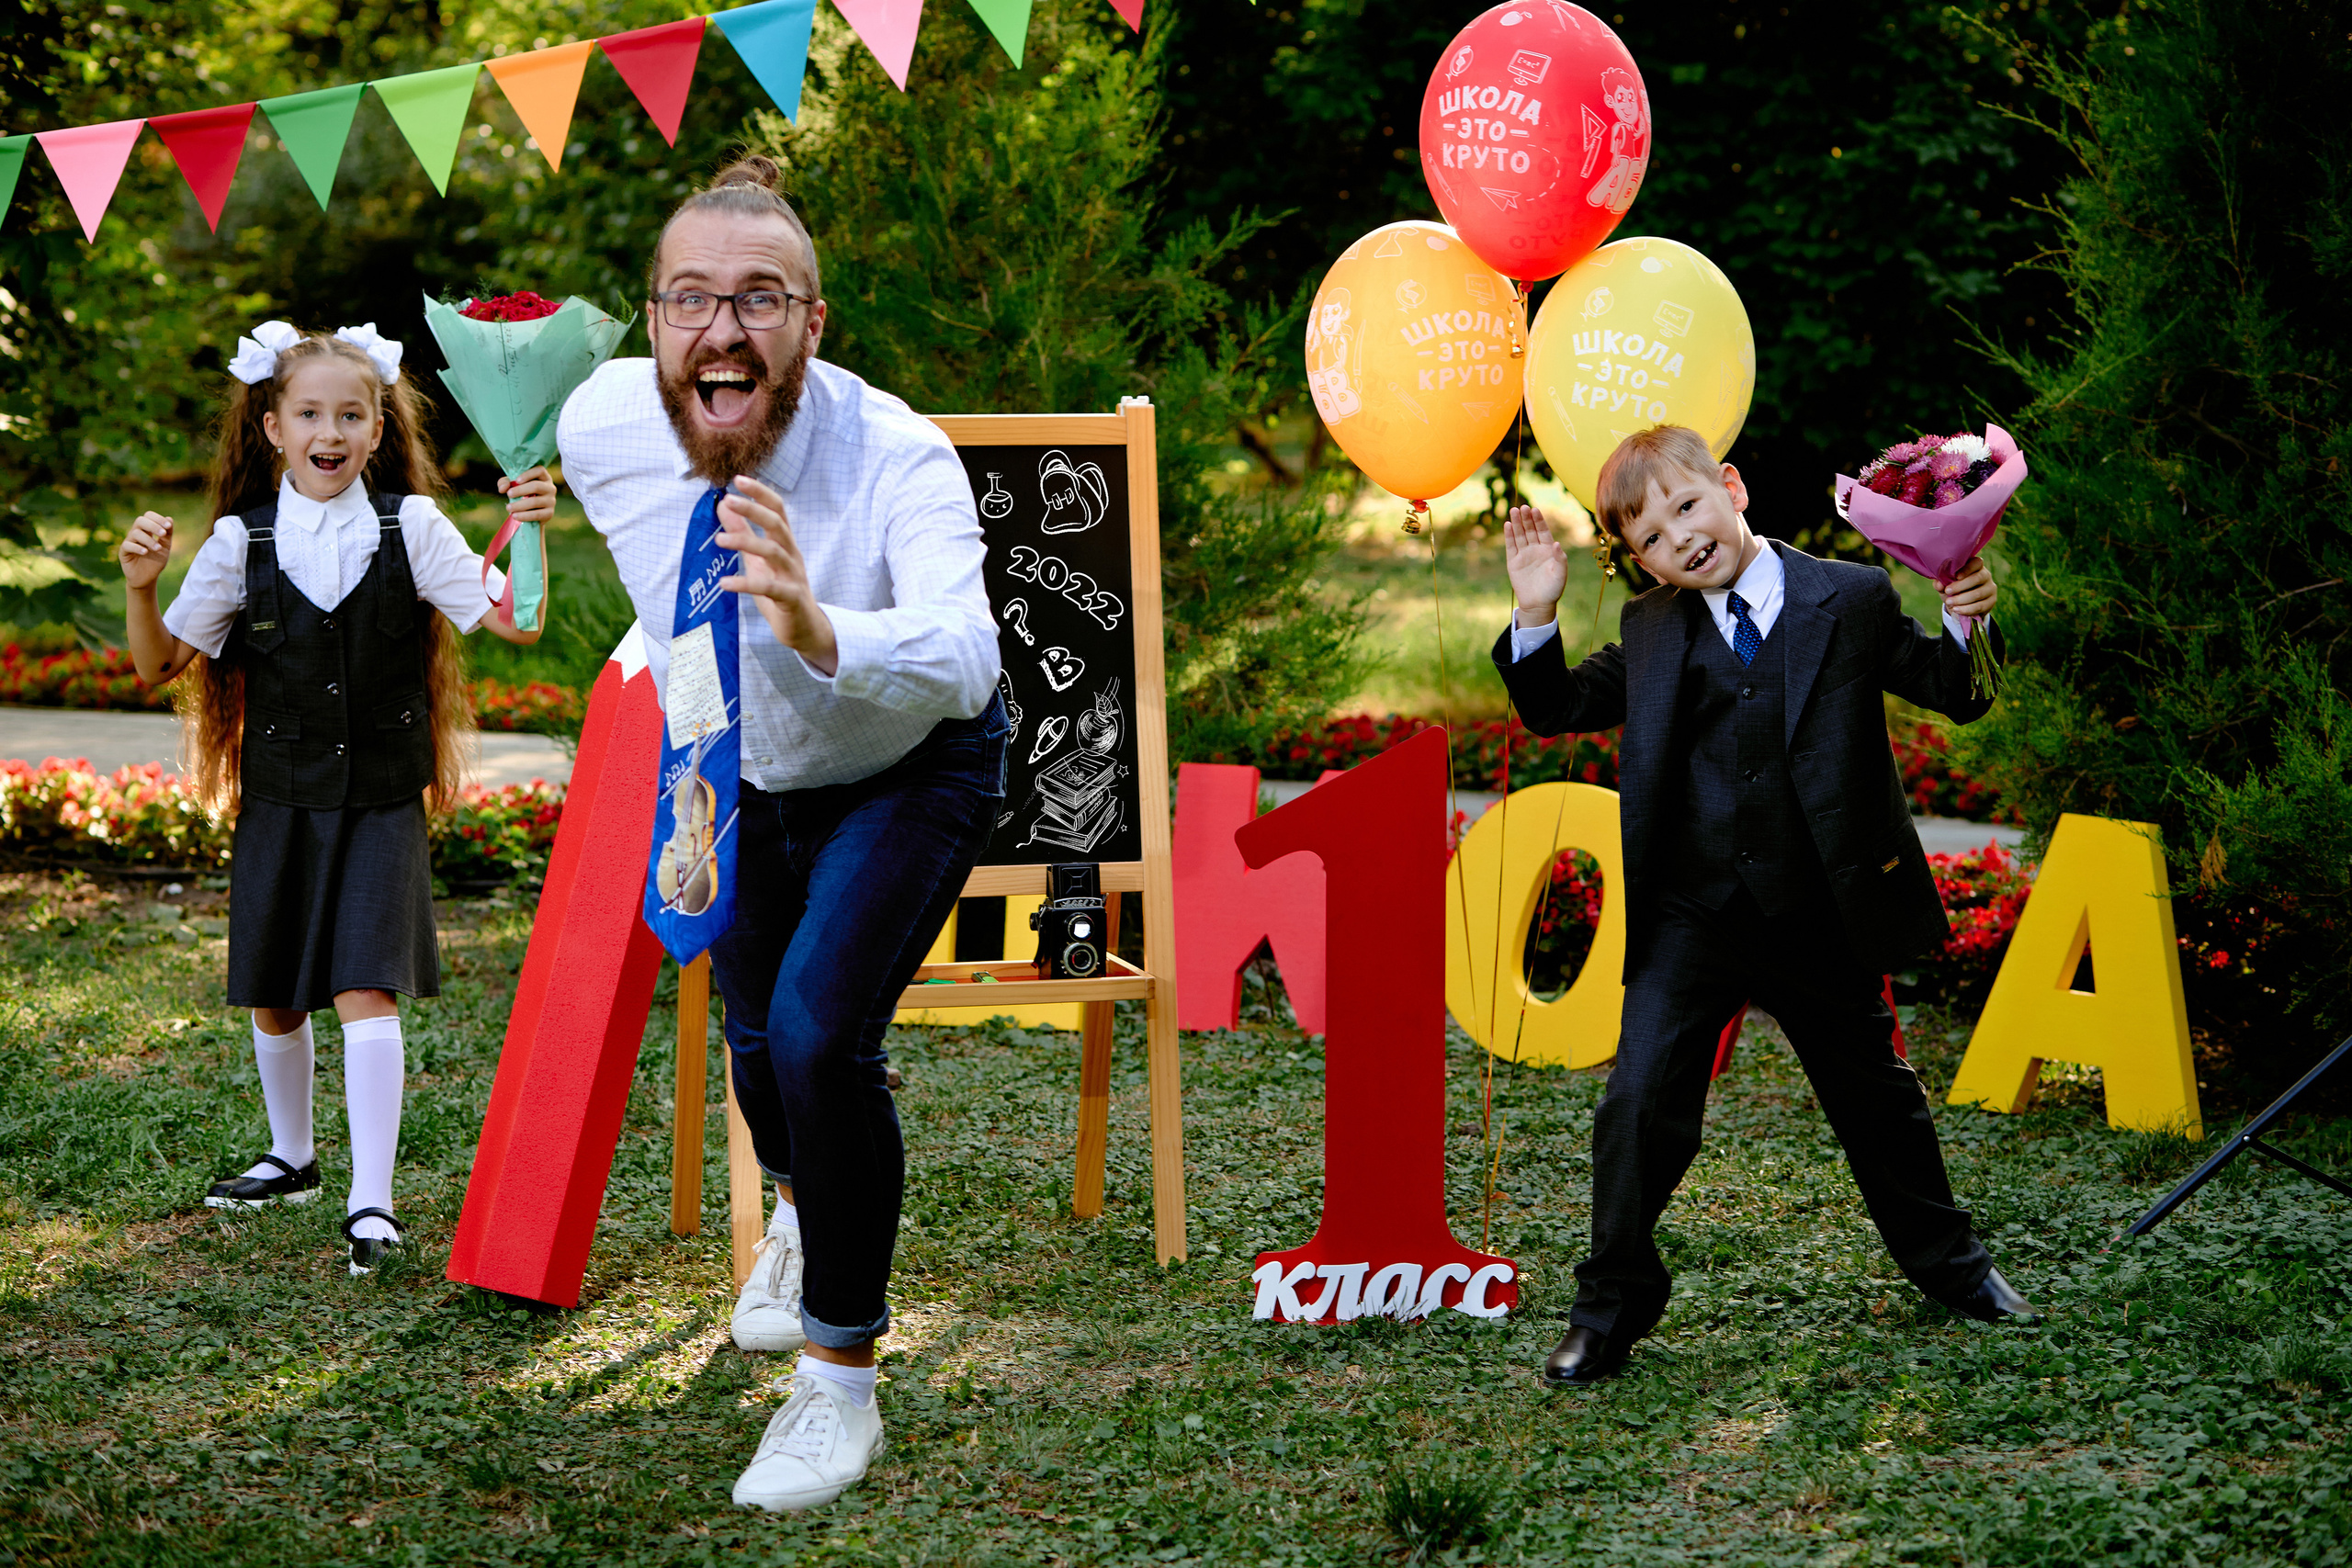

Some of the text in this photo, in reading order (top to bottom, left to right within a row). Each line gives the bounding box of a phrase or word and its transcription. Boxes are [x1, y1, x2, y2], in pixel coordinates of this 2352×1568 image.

[1438, 85, 1542, 125] ШКОЛА
[1442, 142, 1530, 174] КРУТО
[1400, 310, 1506, 347] ШКОЛА
[1572, 330, 1685, 378] ШКОЛА
[1419, 364, 1504, 390] КРУТО
[1571, 381, 1668, 423] КРУТО
[1006, 545, 1125, 631] 2022
